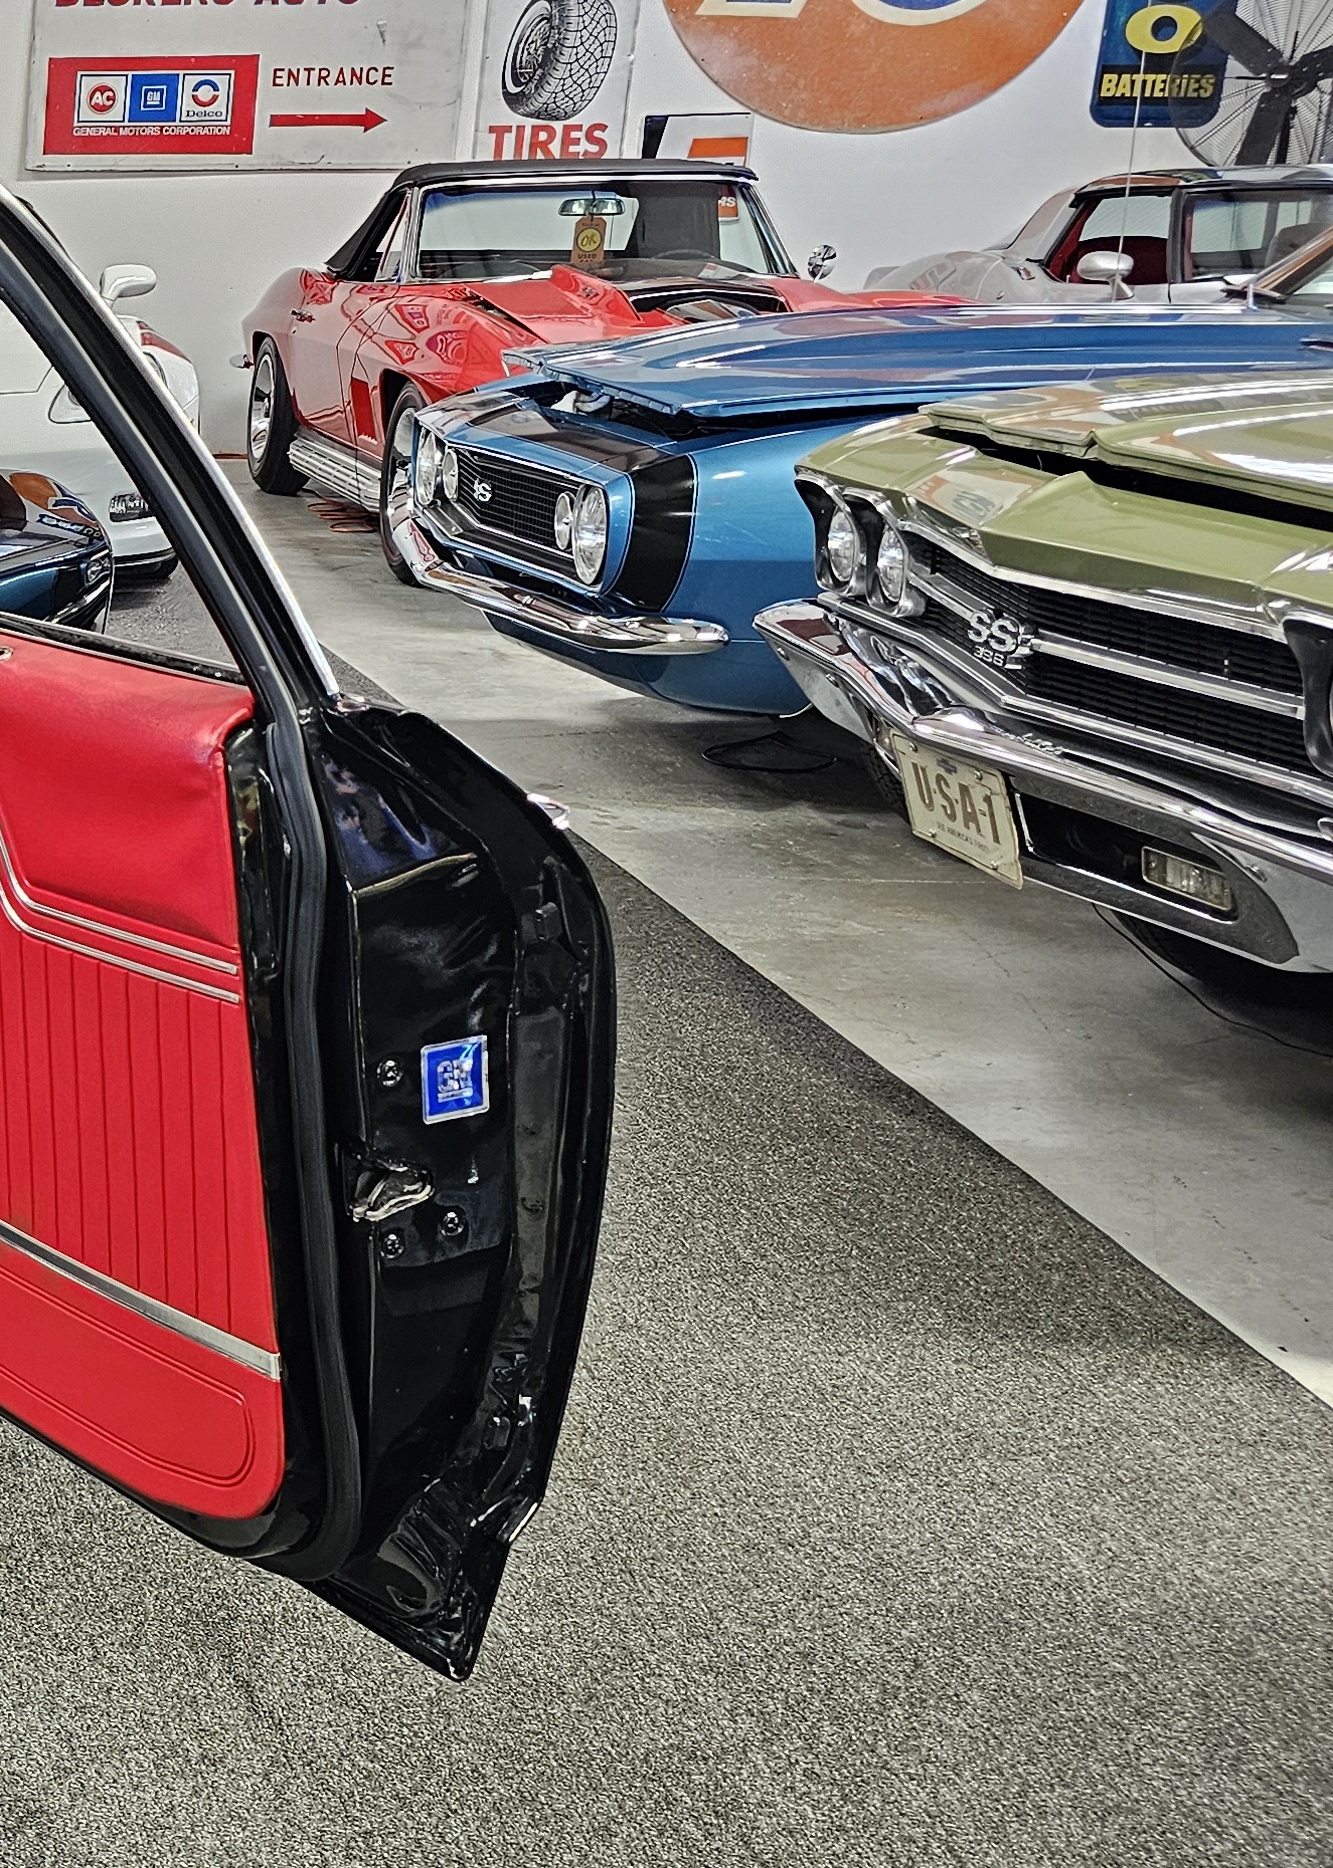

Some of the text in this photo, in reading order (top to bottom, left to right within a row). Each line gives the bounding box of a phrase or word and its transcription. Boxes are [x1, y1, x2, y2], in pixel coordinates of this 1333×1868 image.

[272, 66, 394, 87] ENTRANCE
[1100, 73, 1215, 98] BATTERIES
[91, 90, 114, 106] AC
[147, 91, 161, 101] GM
[185, 109, 223, 118] Delco
[73, 126, 230, 136] GENERAL MOTORS CORPORATION
[488, 123, 609, 160] TIRES
[968, 610, 1018, 652] SS
[974, 645, 1005, 667] 396
[437, 1058, 474, 1093] GM
